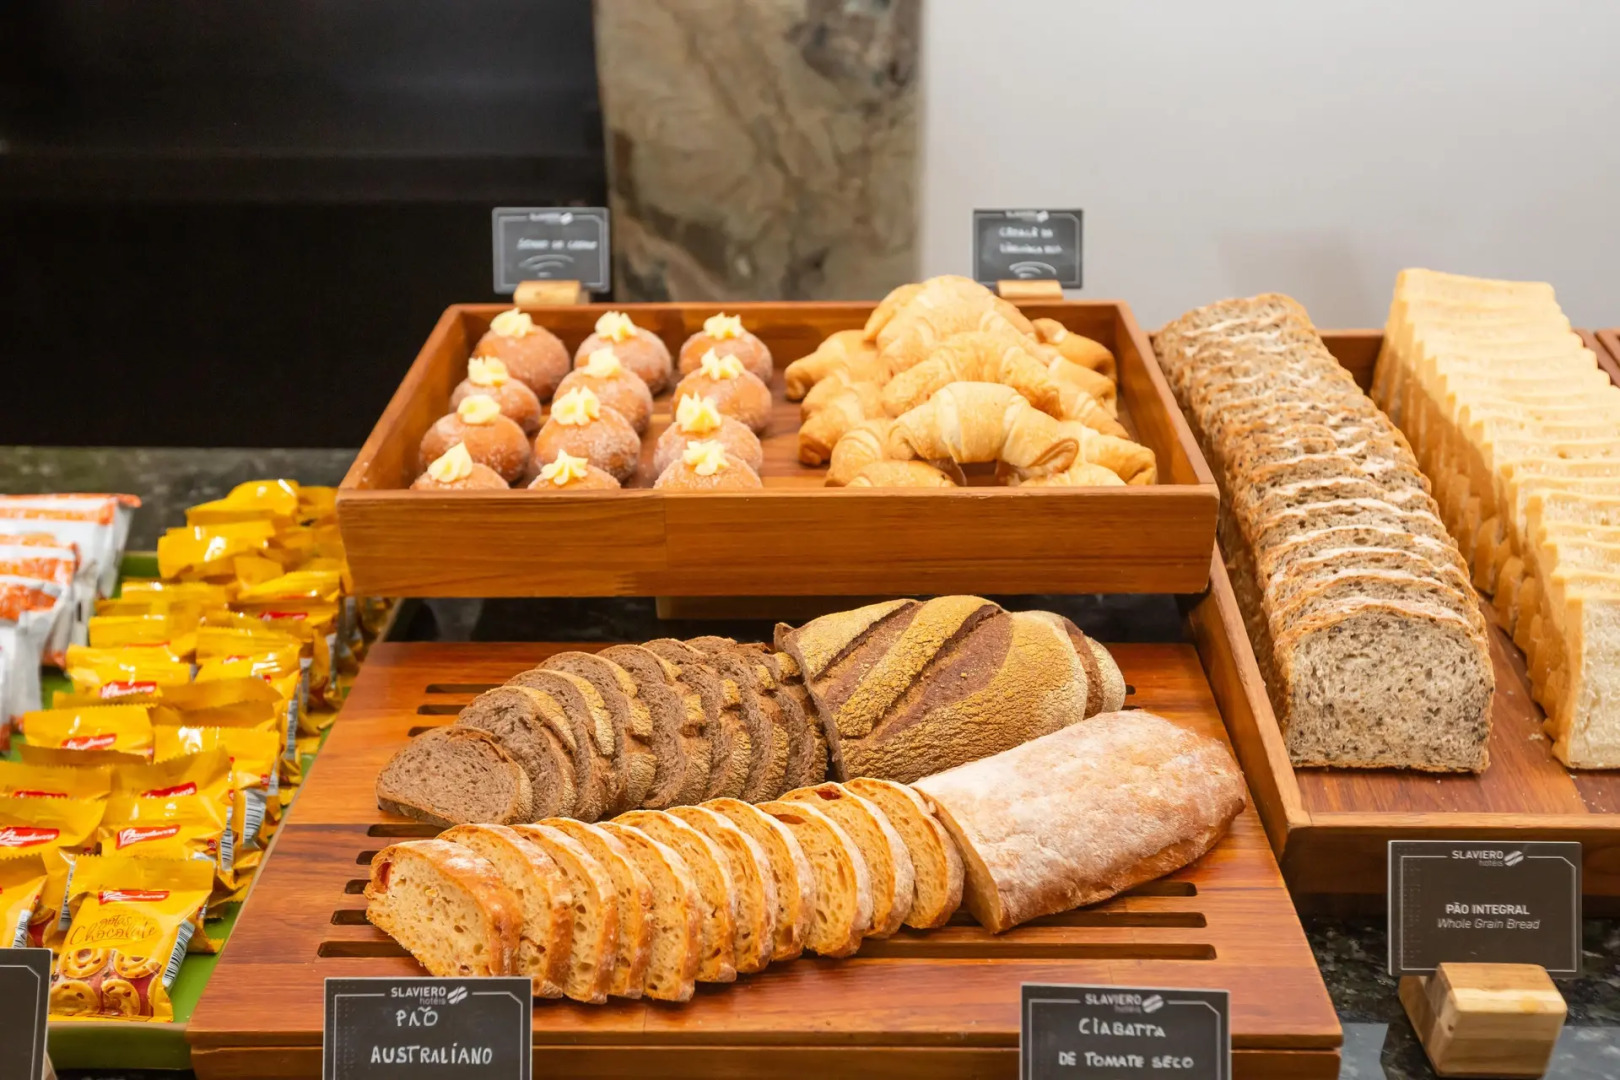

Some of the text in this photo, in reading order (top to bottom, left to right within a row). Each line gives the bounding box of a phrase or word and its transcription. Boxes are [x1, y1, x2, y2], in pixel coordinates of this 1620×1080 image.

[1452, 850, 1503, 860] SLAVIERO
[1445, 902, 1530, 915] PÃO INTEGRAL
[1437, 918, 1540, 929] Whole Grain Bread
[70, 921, 156, 945] Chocolate
[391, 986, 446, 998] SLAVIERO
[1085, 993, 1141, 1006] SLAVIERO
[395, 1006, 439, 1027] PÃO
[1078, 1017, 1166, 1038] CIABATTA
[1058, 1051, 1194, 1069] DE TOMATE SECO
